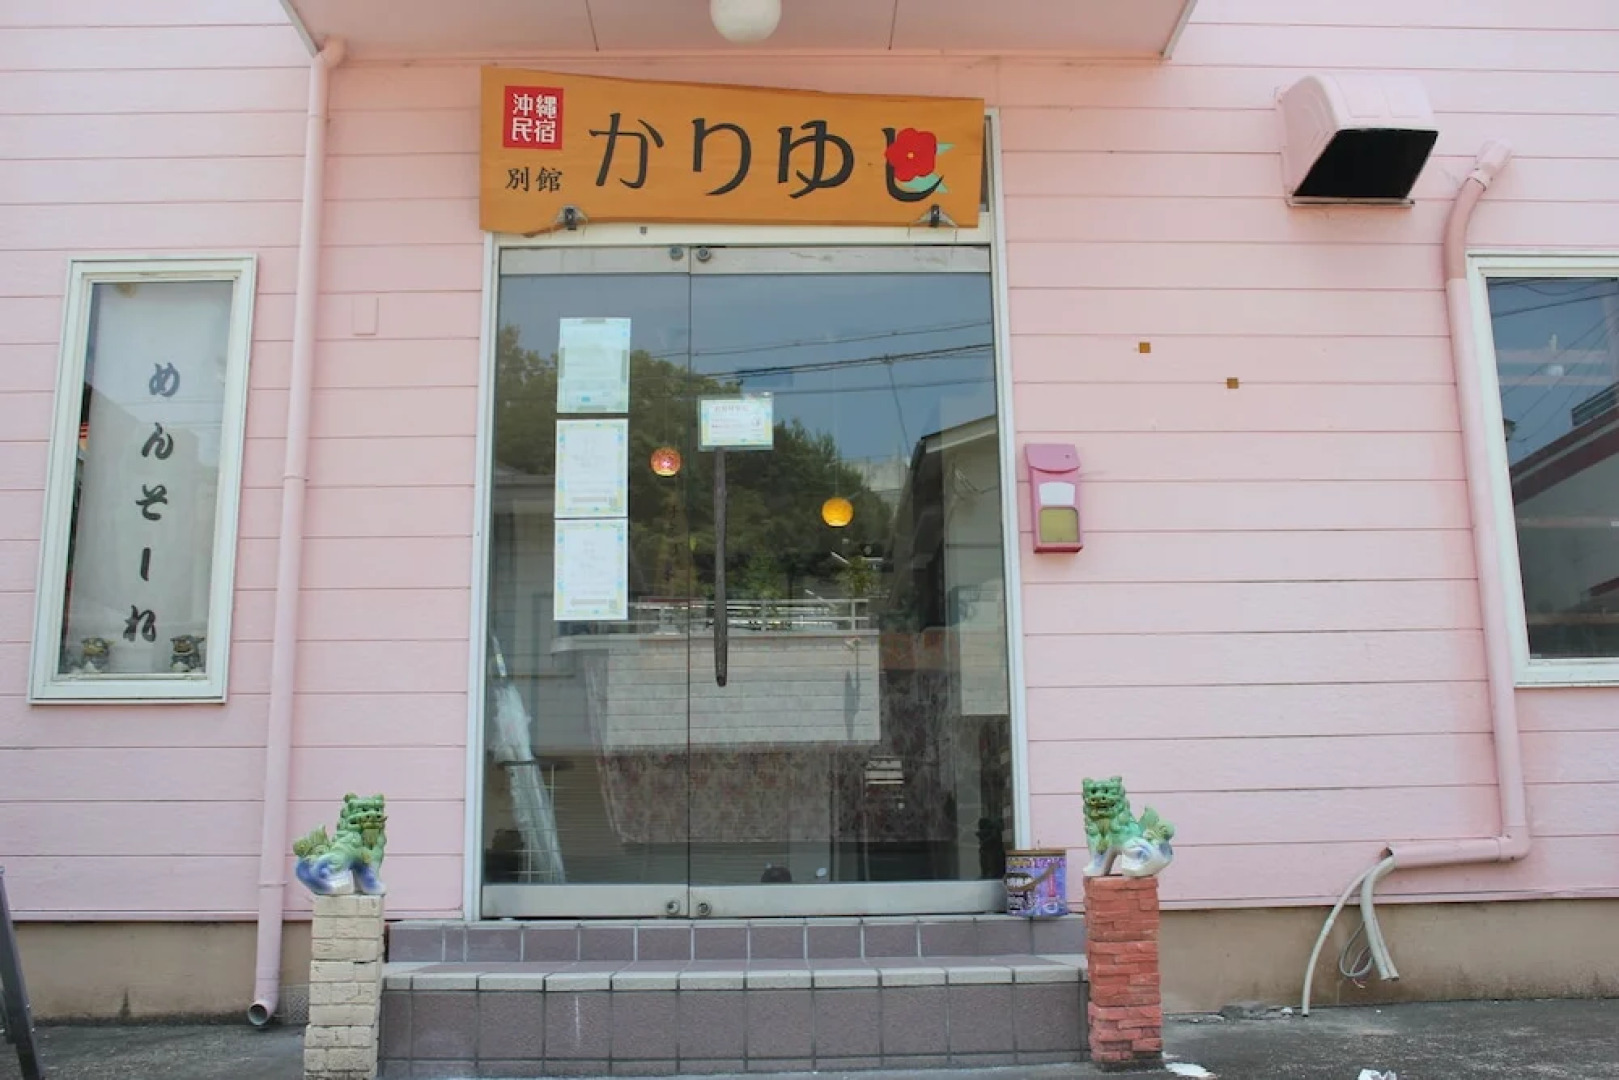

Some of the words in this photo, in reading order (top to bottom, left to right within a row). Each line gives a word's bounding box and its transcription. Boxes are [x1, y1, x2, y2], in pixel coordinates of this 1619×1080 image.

[512, 93, 558, 118] 沖縄
[511, 118, 556, 144] 民宿
[589, 112, 944, 203] かりゆし
[505, 166, 563, 194] 別館
[122, 362, 181, 643] めんそーれ
